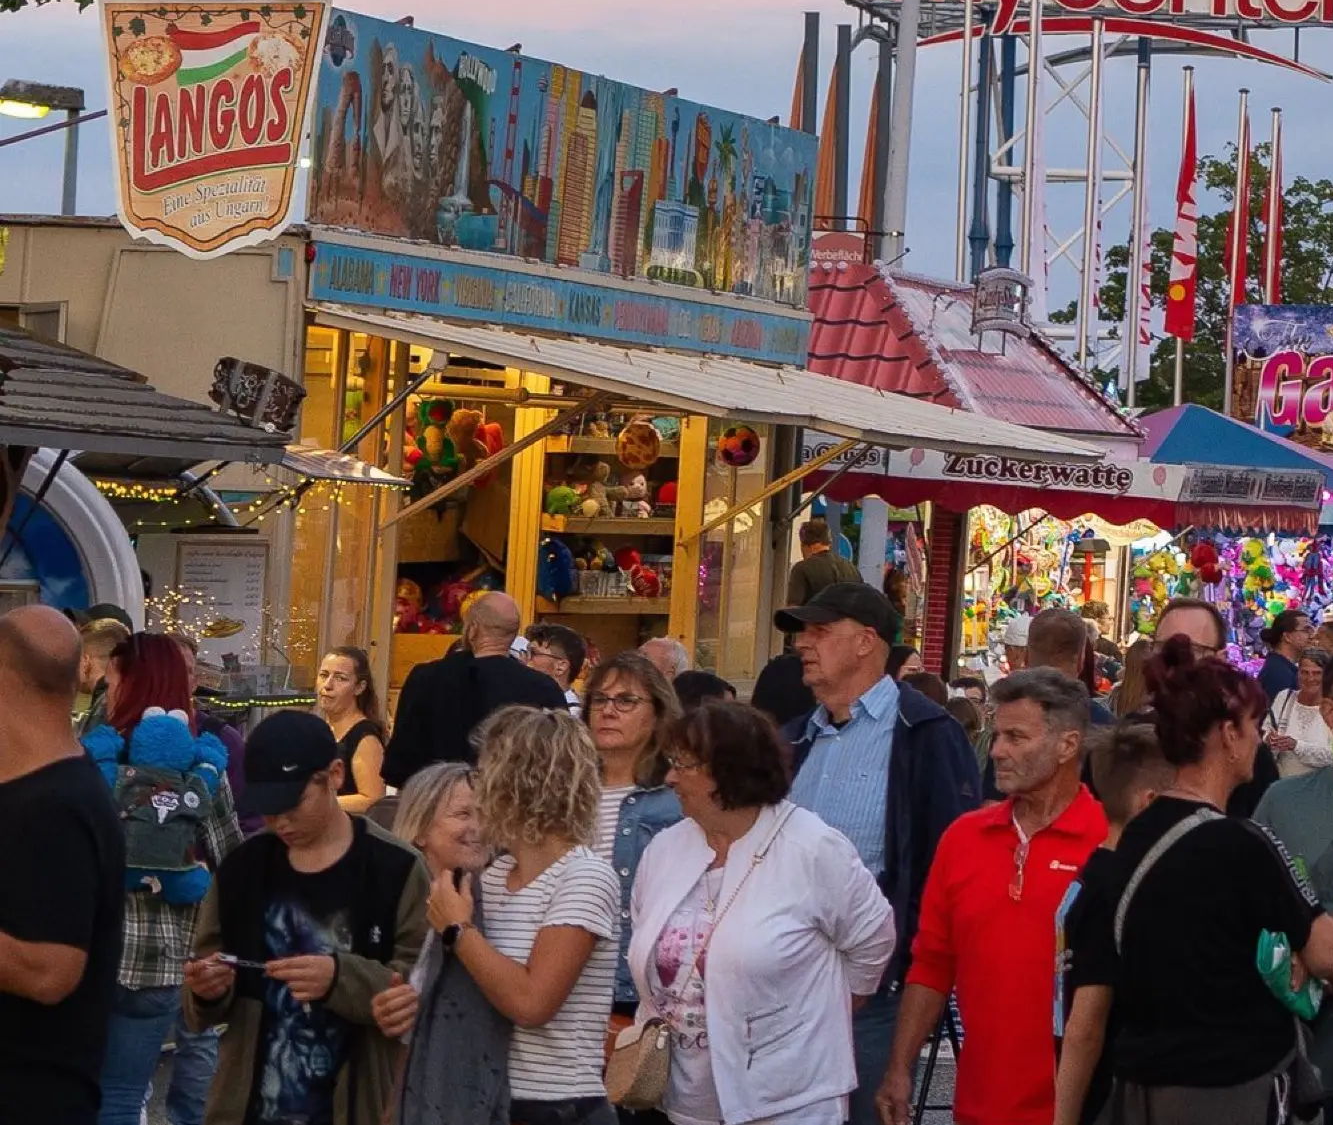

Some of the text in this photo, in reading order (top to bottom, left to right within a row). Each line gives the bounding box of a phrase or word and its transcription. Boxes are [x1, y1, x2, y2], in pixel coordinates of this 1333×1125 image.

[163, 176, 266, 217] Eine Spezialität
[190, 194, 270, 229] aus Ungarn!
[389, 263, 412, 300] NEW
[415, 267, 442, 305] YORK
[944, 452, 1133, 490] Zuckerwatte
